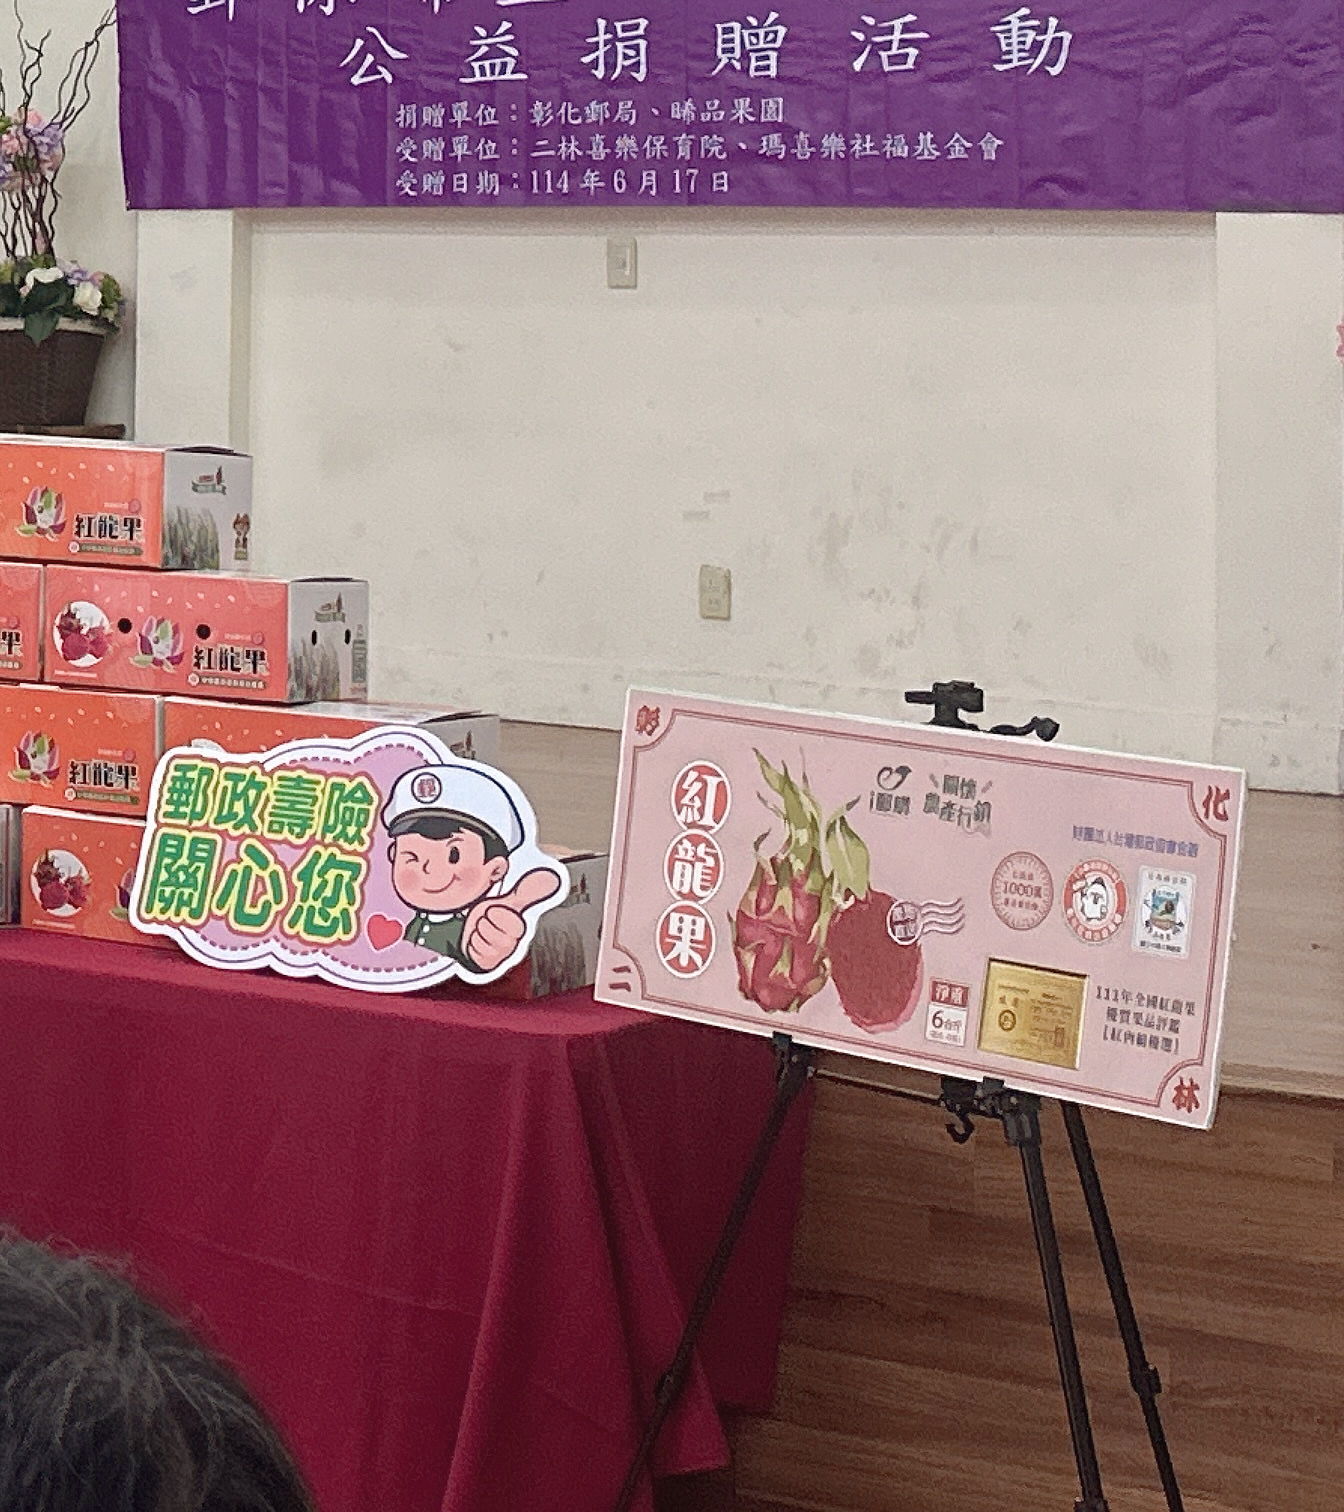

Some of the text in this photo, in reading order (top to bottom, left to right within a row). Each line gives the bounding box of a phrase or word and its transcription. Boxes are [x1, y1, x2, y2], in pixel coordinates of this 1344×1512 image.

[338, 5, 1074, 87] 公益捐贈活動
[162, 760, 379, 851] 郵政壽險
[1202, 784, 1231, 822] 化
[144, 832, 365, 942] 關心您
[664, 769, 727, 970] 紅龍果
[1172, 1077, 1201, 1115] 林
